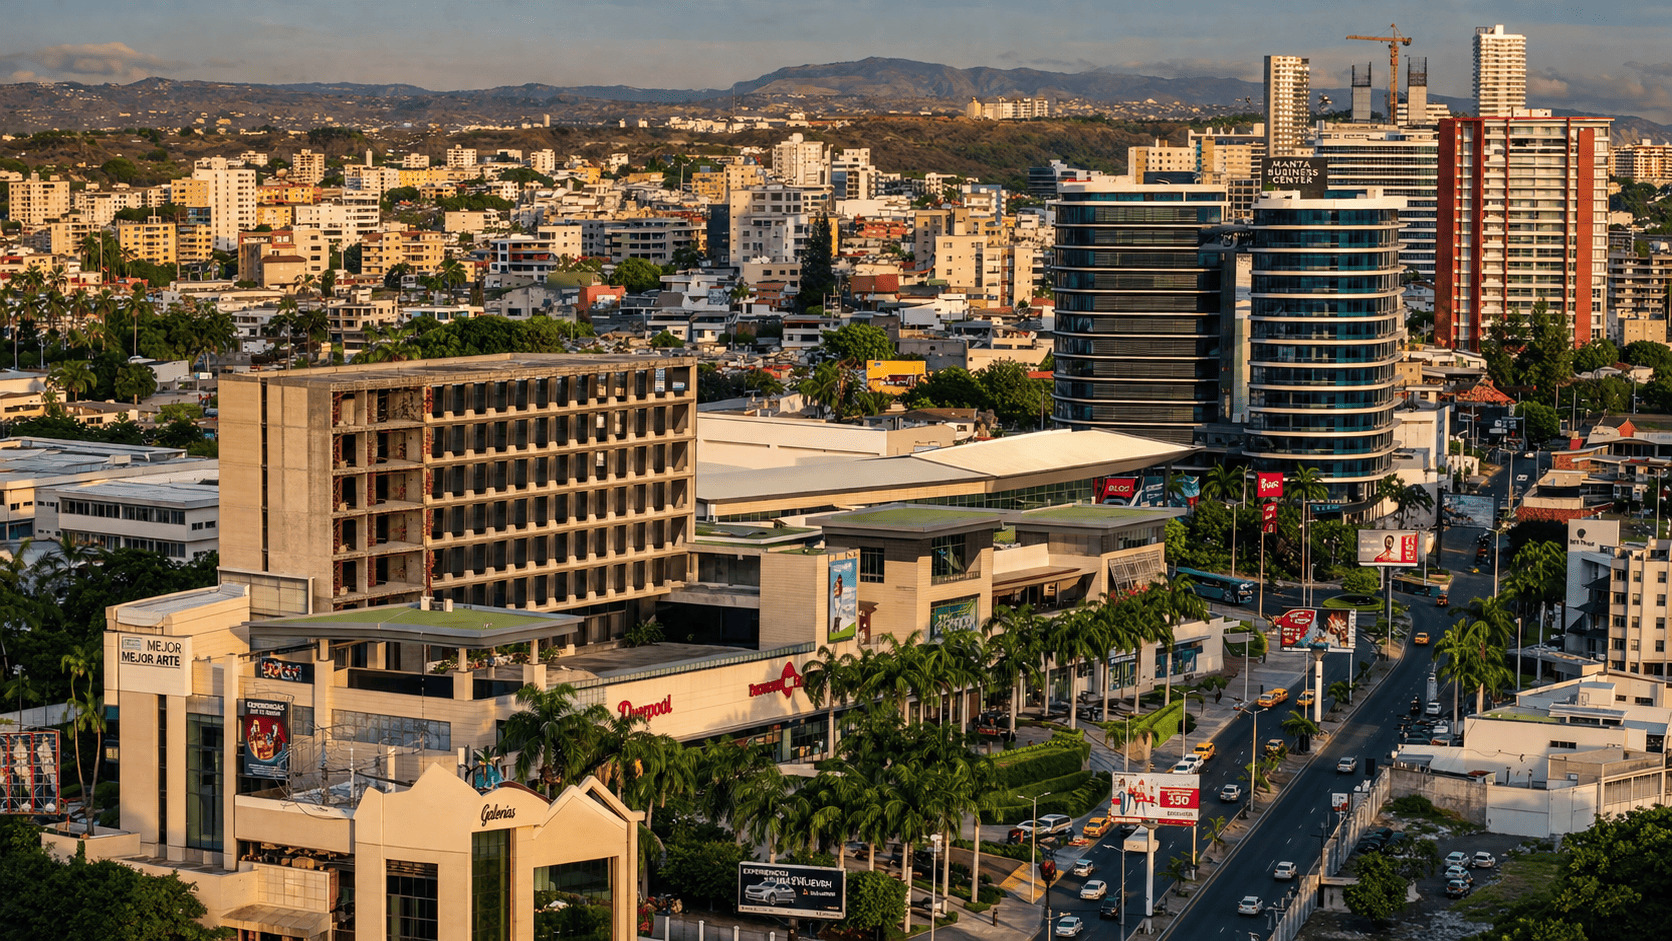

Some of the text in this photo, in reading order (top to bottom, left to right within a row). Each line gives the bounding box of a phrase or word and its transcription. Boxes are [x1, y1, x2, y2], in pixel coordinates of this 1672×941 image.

[1272, 160, 1311, 168] MANTA
[1272, 176, 1313, 184] CENTER
[147, 640, 182, 653] MEJOR
[121, 651, 180, 666] MEJOR ARTE
